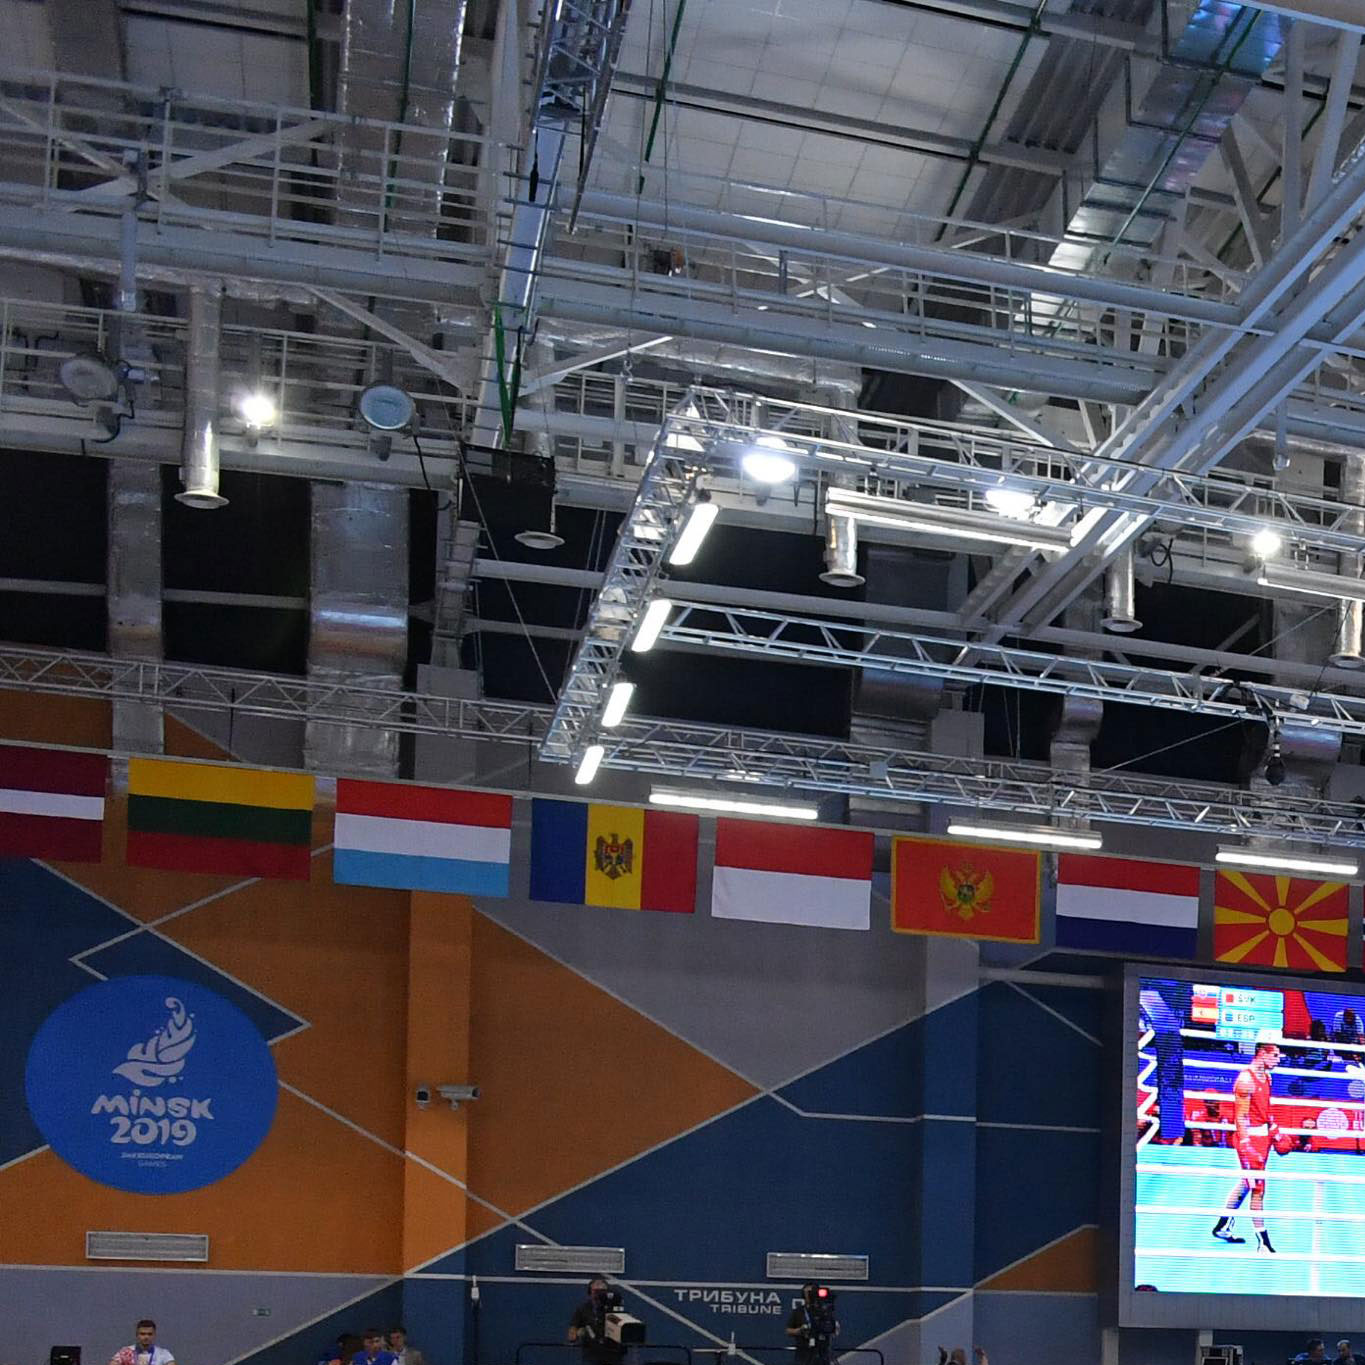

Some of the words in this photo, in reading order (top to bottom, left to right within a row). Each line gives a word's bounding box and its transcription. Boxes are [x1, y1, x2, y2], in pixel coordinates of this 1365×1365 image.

[91, 1089, 214, 1120] MINSK
[110, 1116, 197, 1146] 2019
[674, 1288, 782, 1304] ТРИБУНА
[710, 1304, 783, 1315] TRIBUNE
